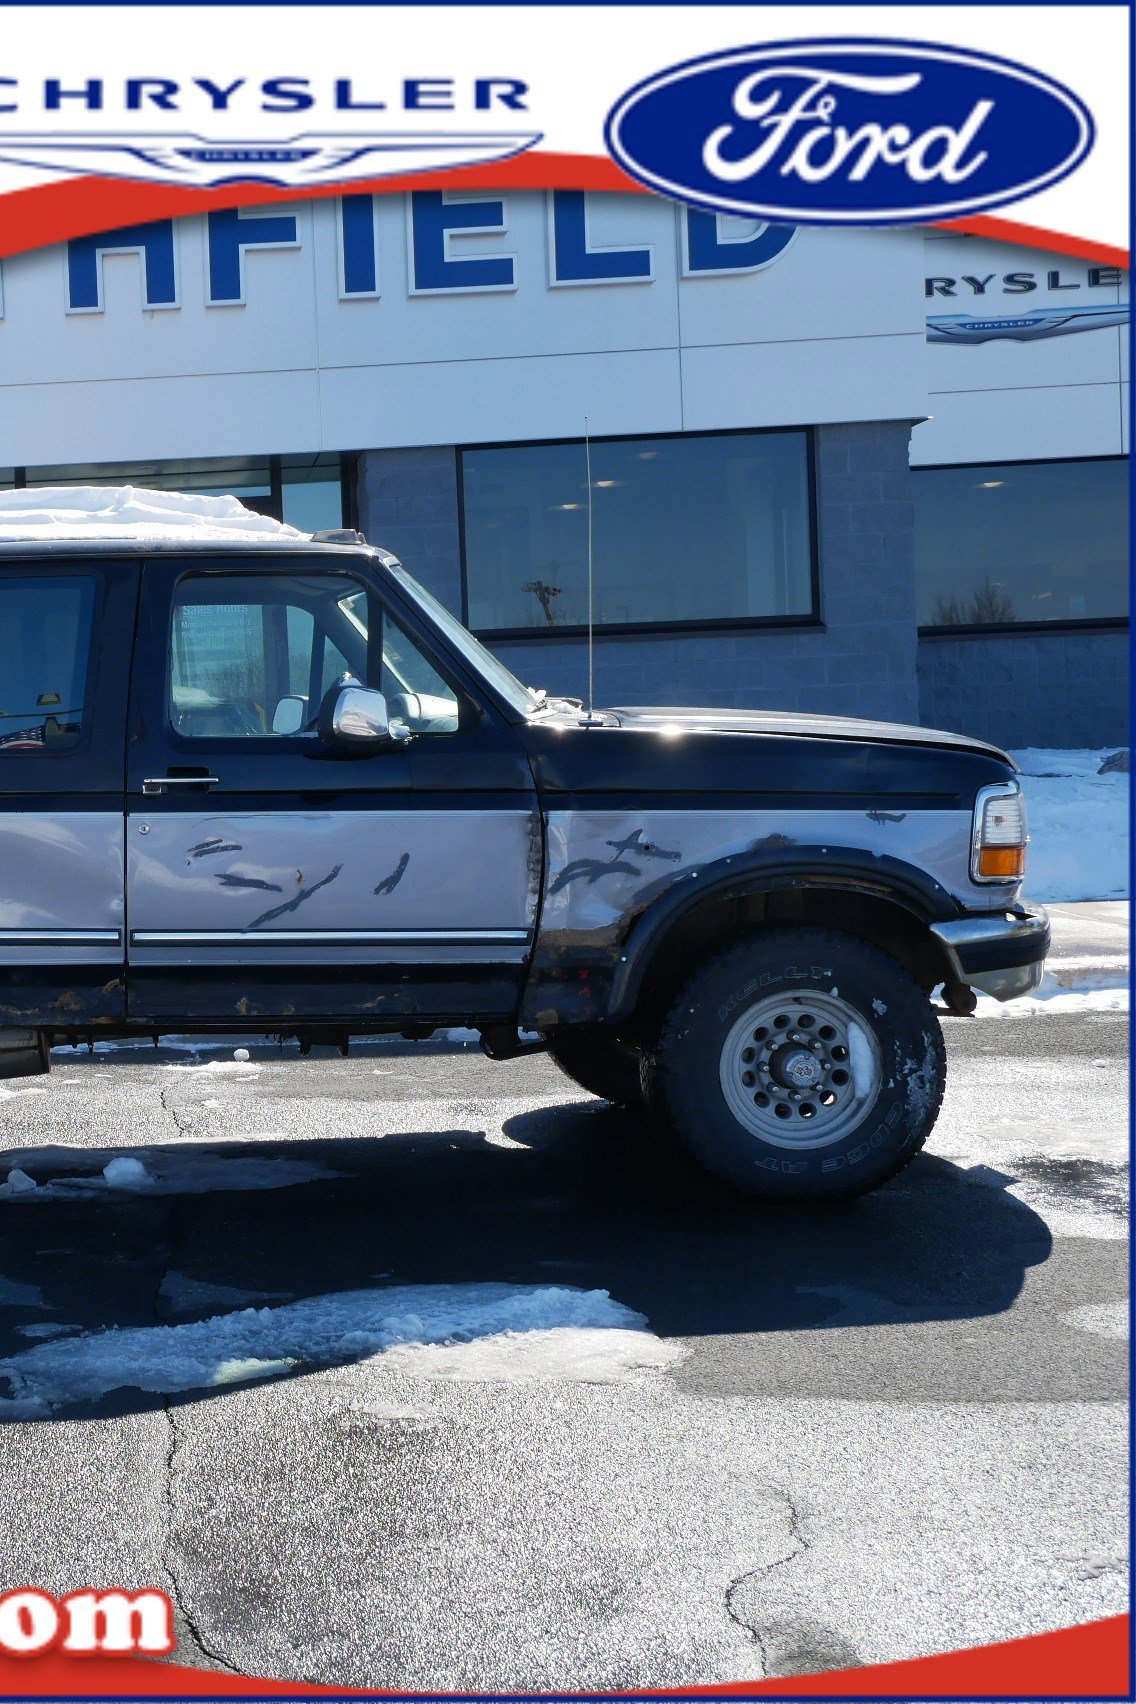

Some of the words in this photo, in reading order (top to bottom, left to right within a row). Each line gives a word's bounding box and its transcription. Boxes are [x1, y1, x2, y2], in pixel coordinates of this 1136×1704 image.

[965, 319, 1035, 330] CHRYSLER
[182, 605, 213, 616] Sales
[216, 604, 249, 615] Hours
[717, 965, 833, 1022] KELLY
